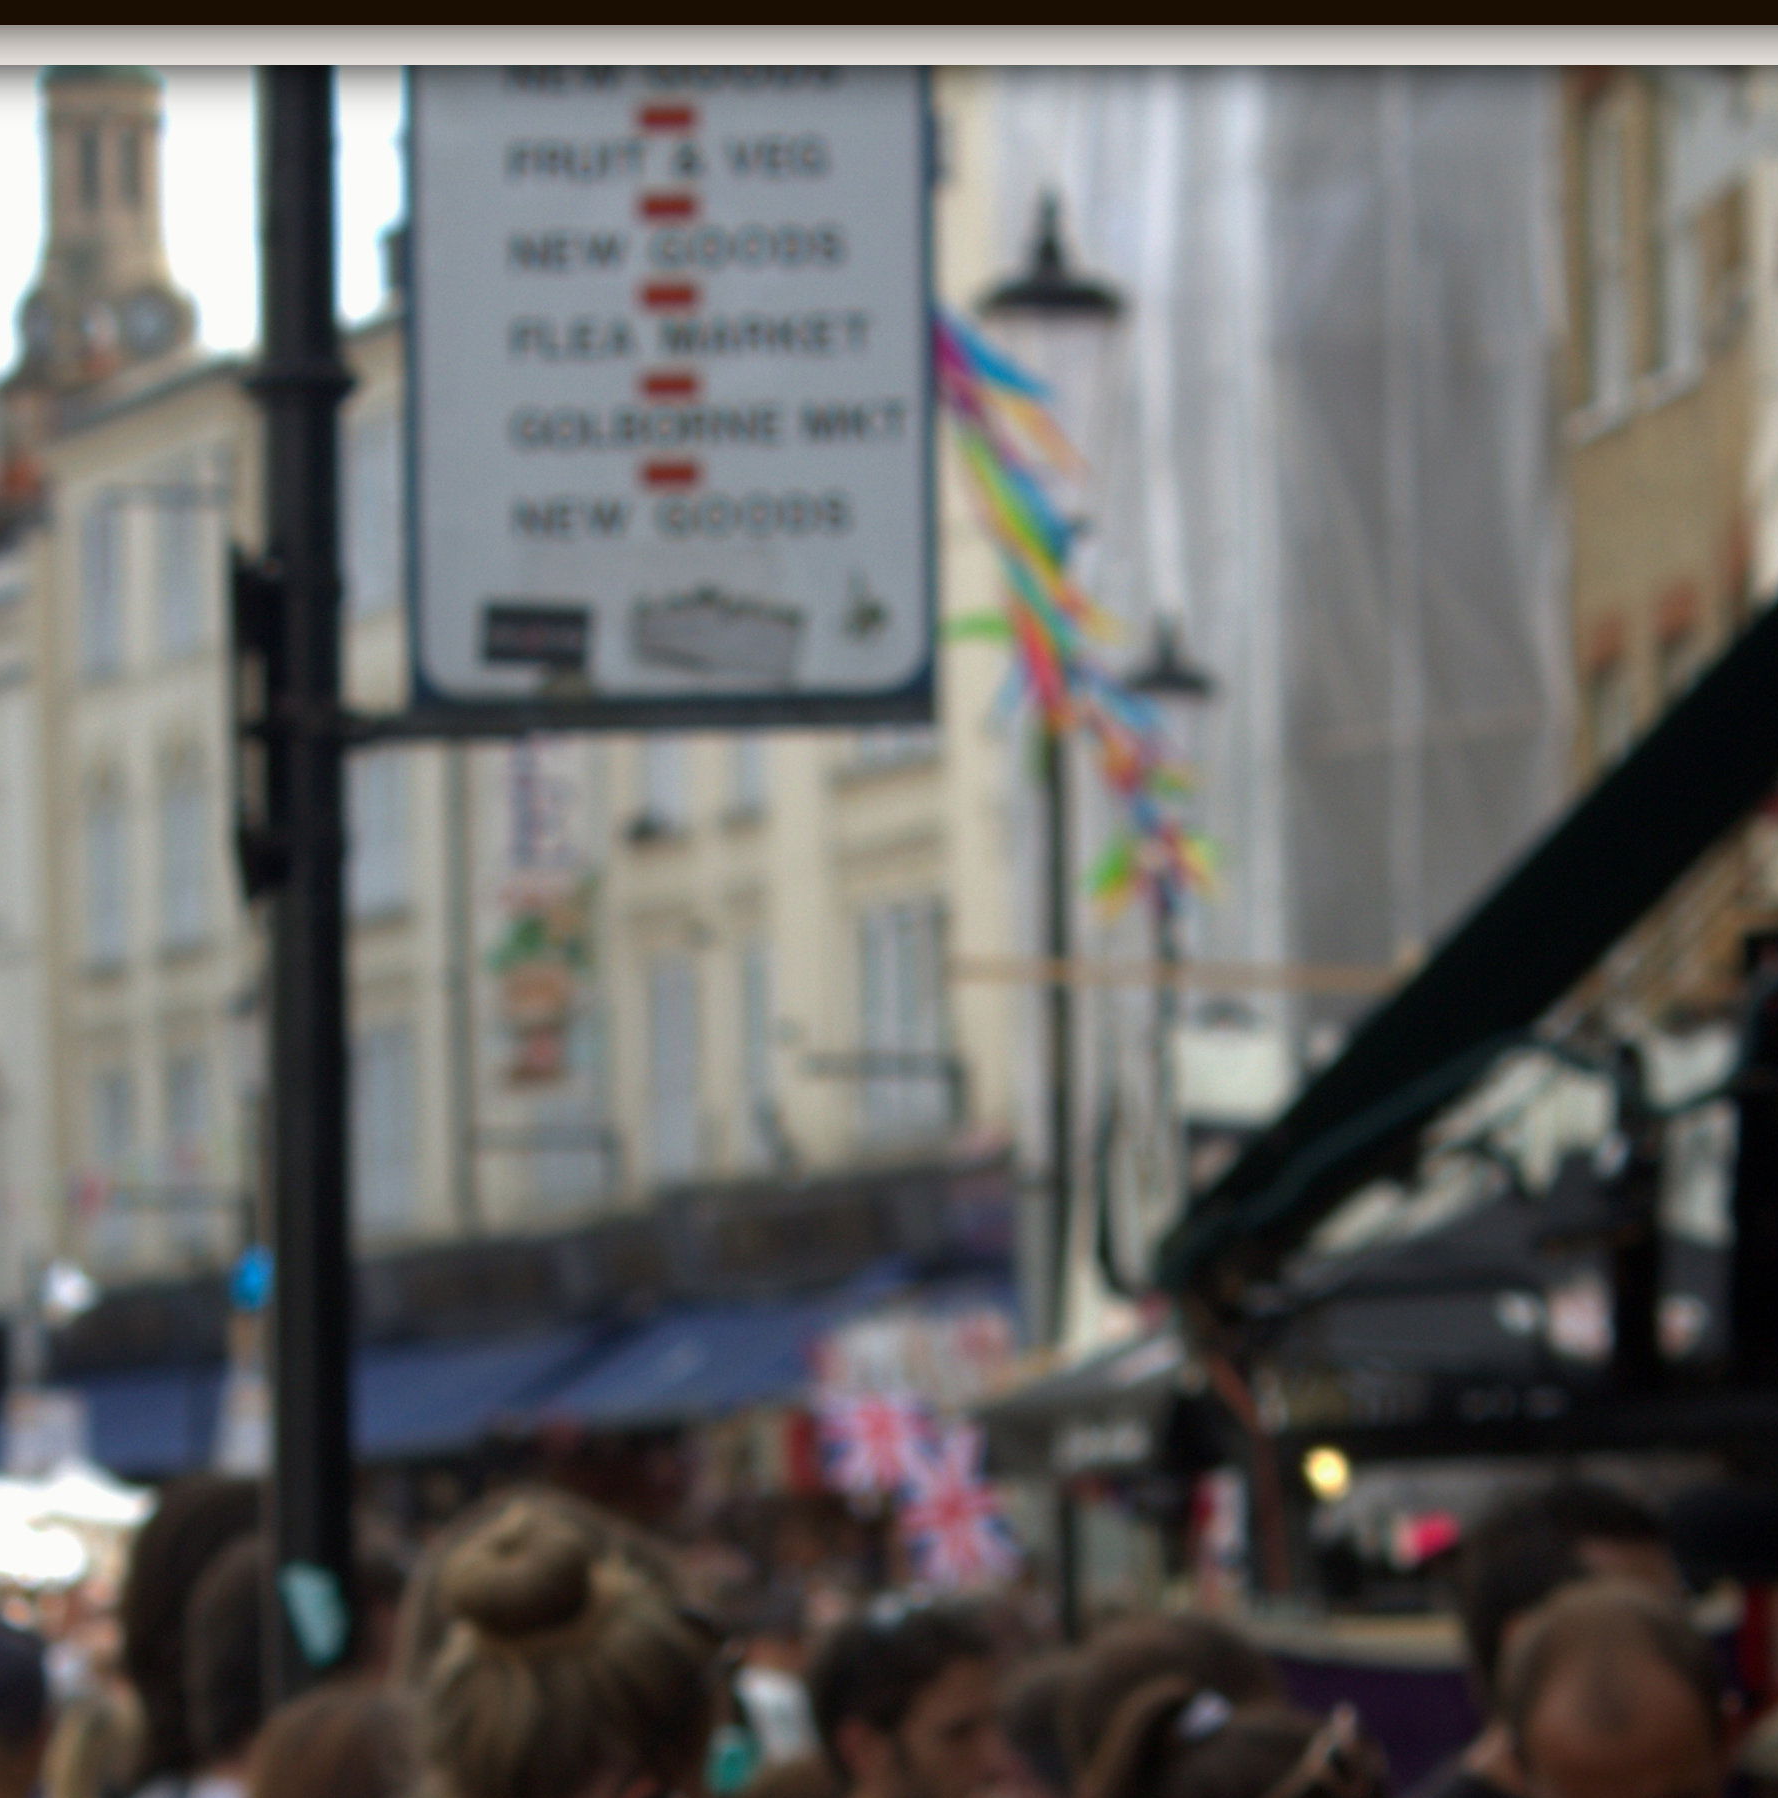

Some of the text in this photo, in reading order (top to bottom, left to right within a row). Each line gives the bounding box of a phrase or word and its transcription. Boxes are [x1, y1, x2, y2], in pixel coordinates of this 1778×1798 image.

[506, 135, 829, 182] FRUIT & VEG
[507, 223, 848, 273] NEW GOODS
[508, 310, 869, 362] FLEA MARKET
[508, 399, 907, 449] GOLBORNE MKT
[510, 492, 853, 543] NEW GOODS
